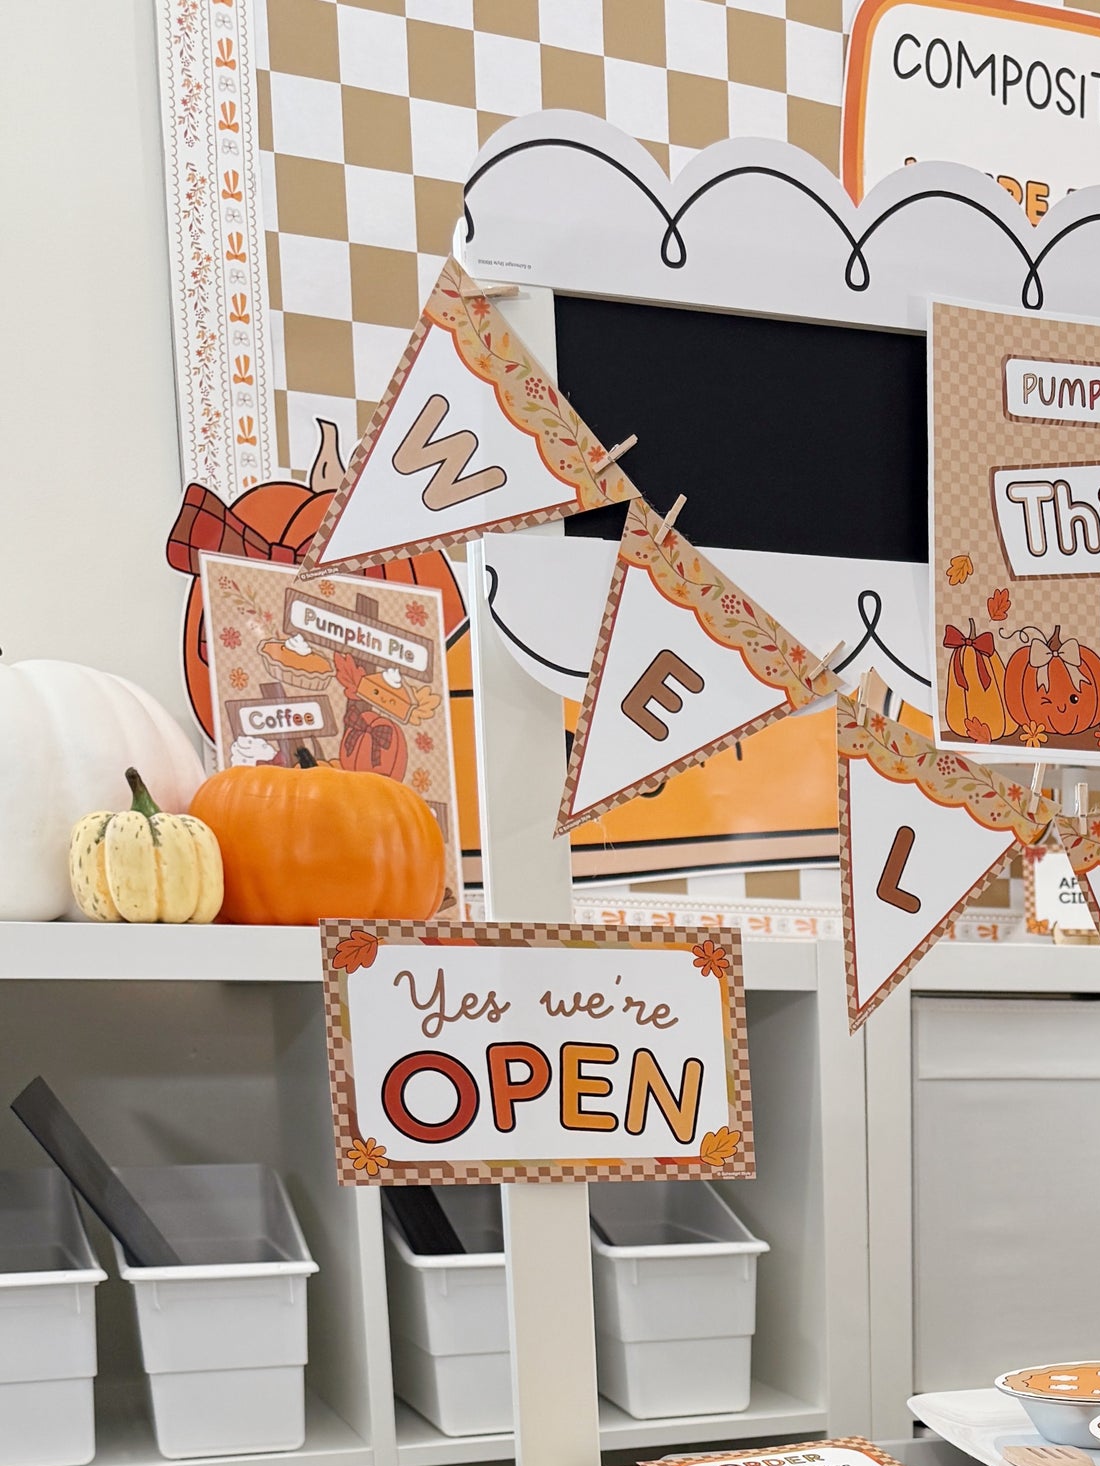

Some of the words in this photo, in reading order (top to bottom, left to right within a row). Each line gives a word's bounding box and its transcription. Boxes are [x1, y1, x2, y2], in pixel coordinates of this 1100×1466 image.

[304, 607, 383, 652] Pumpkin
[388, 638, 415, 663] Pie
[249, 708, 316, 731] Coffee
[393, 968, 512, 1038] Yes
[540, 975, 680, 1030] we're
[381, 1041, 705, 1144] OPEN
